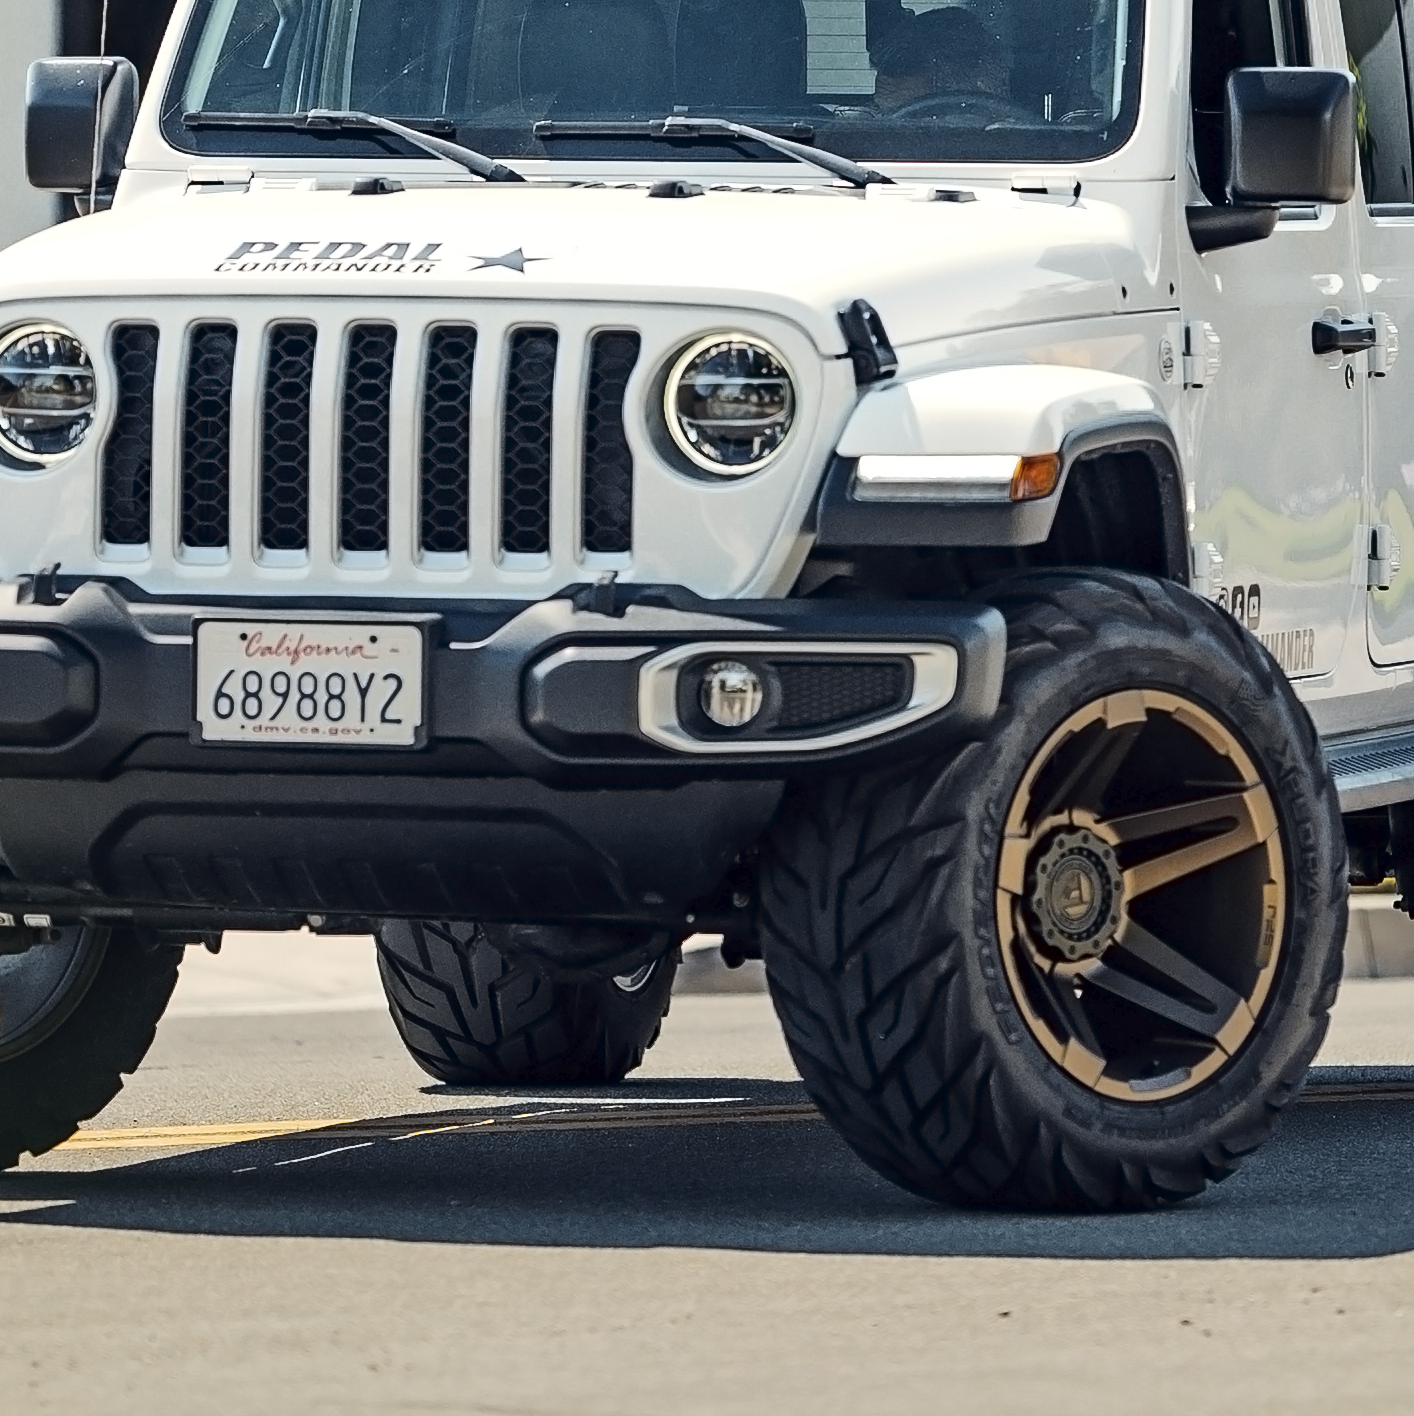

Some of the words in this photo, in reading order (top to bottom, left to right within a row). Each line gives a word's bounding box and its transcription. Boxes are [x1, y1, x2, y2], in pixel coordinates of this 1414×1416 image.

[224, 240, 444, 262] PEDAL
[214, 262, 438, 273] COMMANDER
[244, 630, 379, 666] California
[213, 669, 404, 725] 68988Y2
[251, 723, 364, 736] dmv.ca.gov
